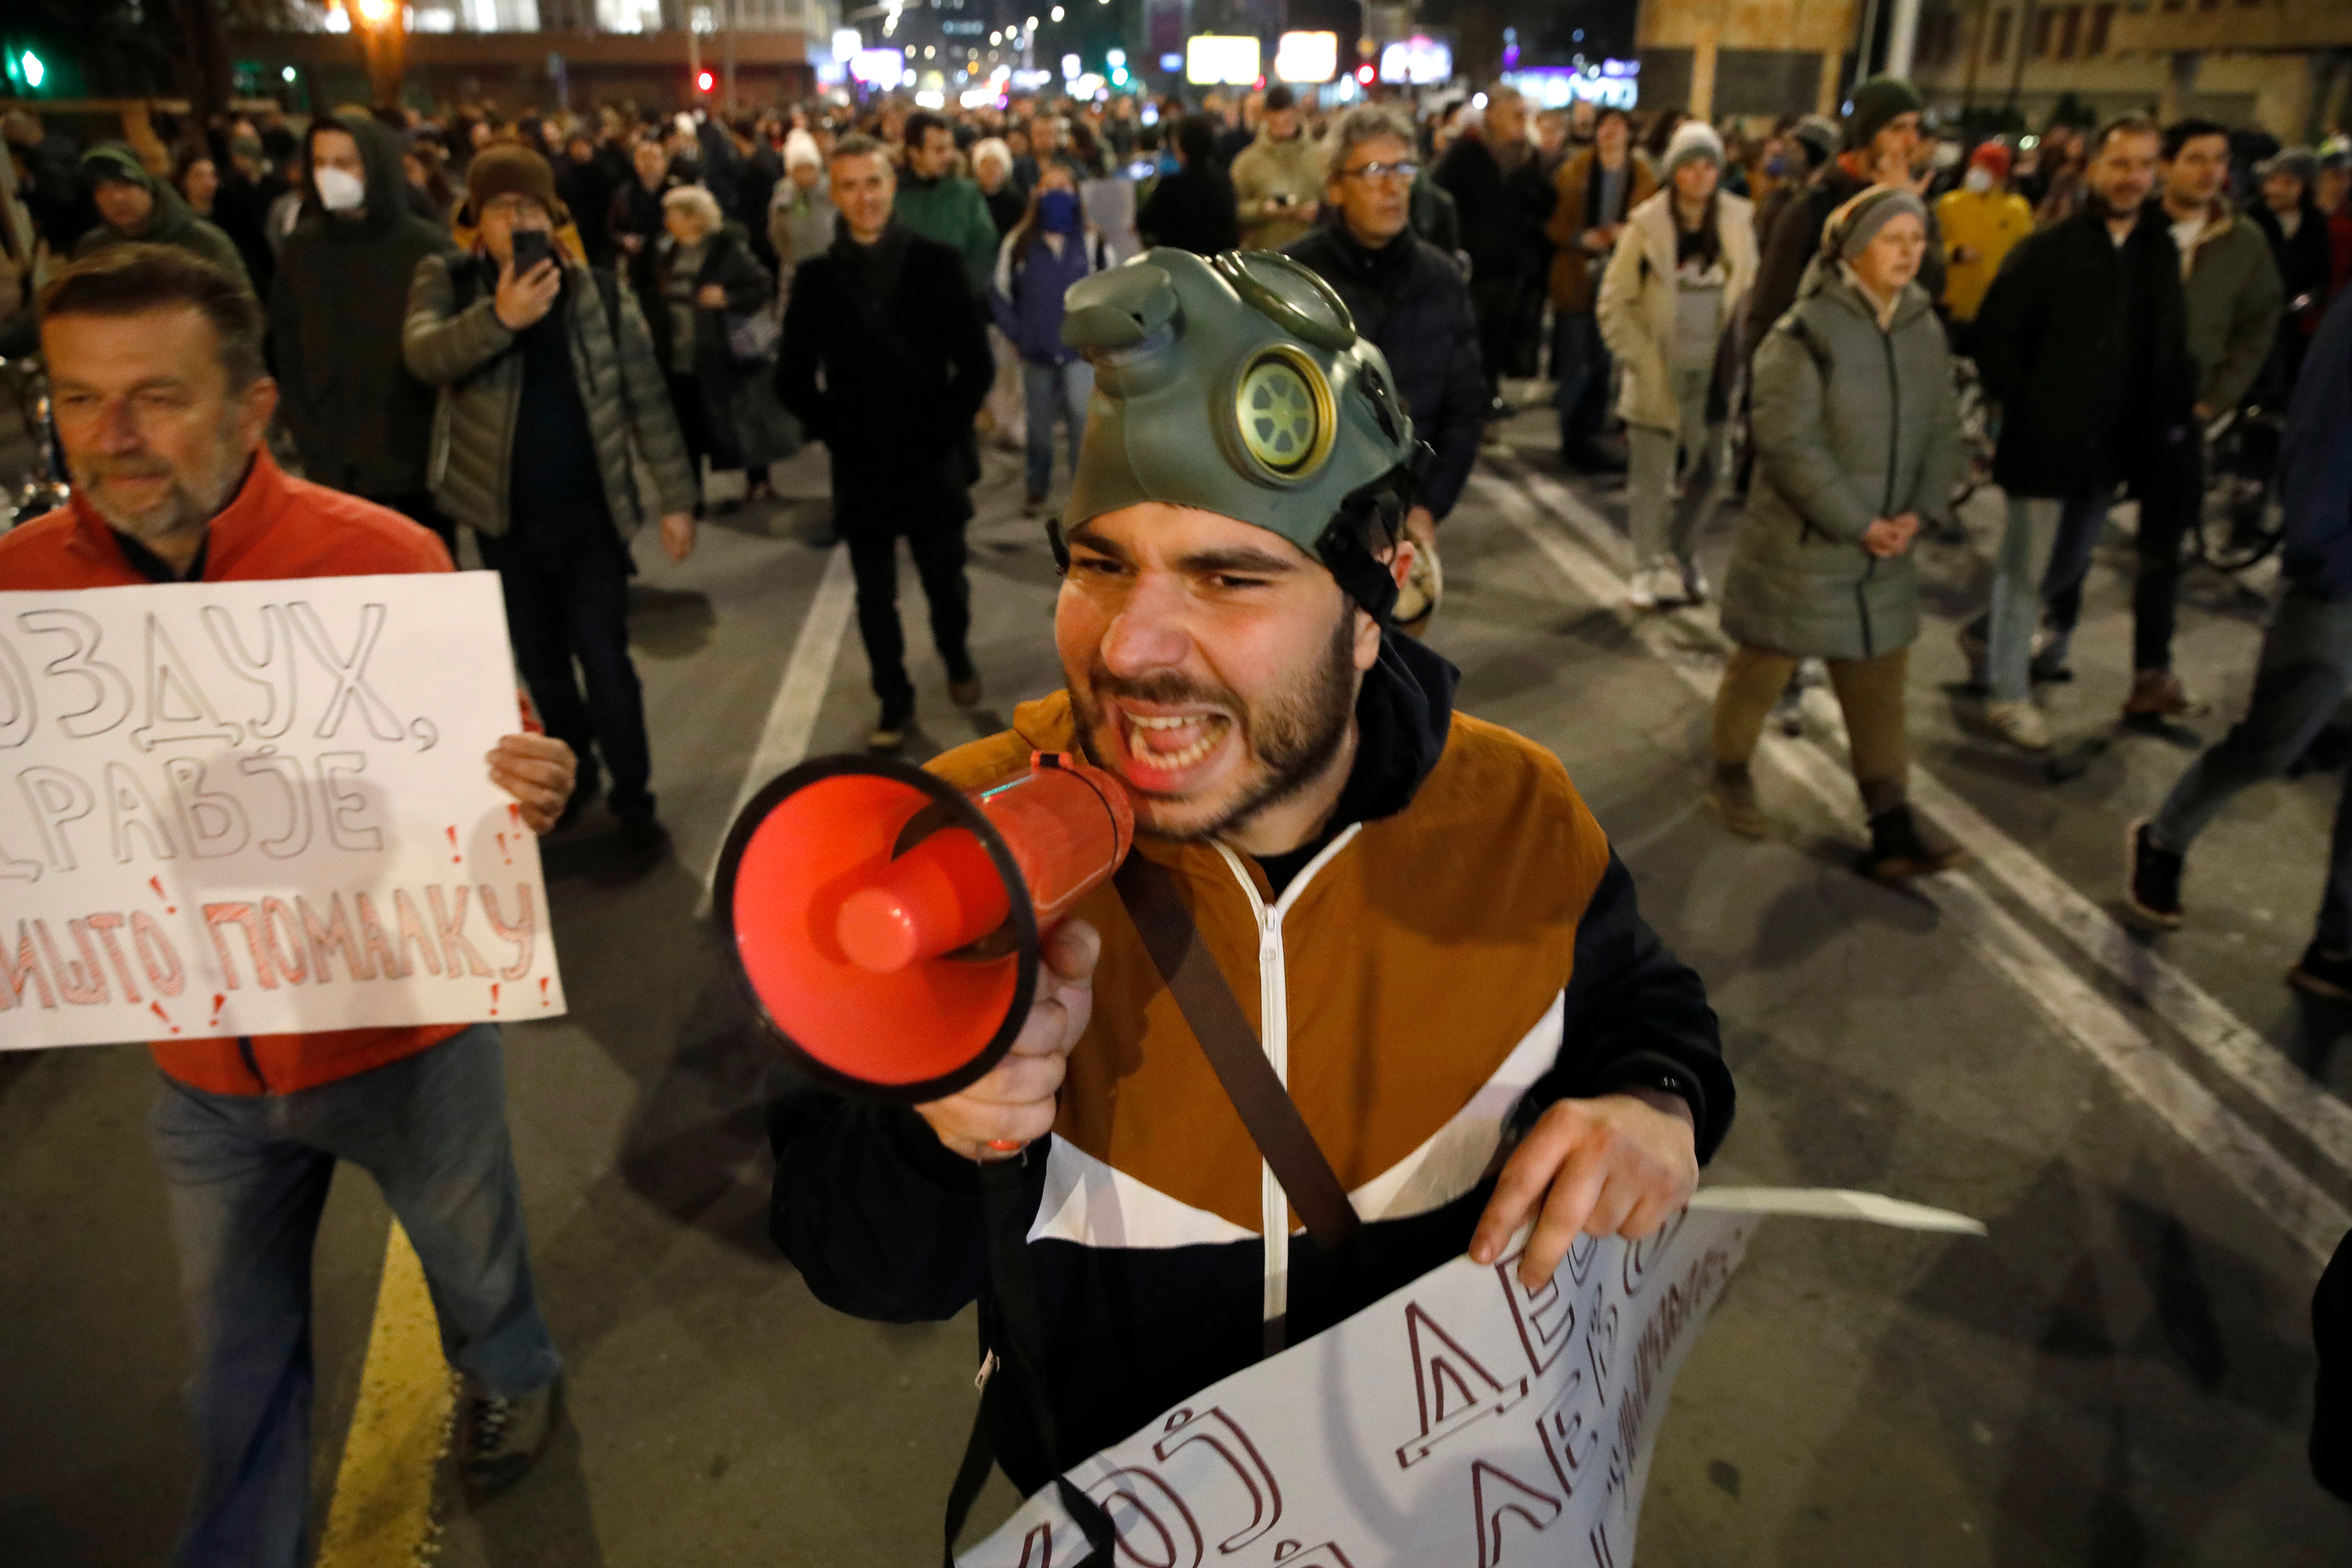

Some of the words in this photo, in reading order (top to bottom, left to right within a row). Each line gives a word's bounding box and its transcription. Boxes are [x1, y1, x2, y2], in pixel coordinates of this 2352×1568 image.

[0, 745, 384, 883] РАВЈЕ
[0, 910, 185, 1011] ИШТО
[202, 882, 534, 990] ПОМАЛКУ
